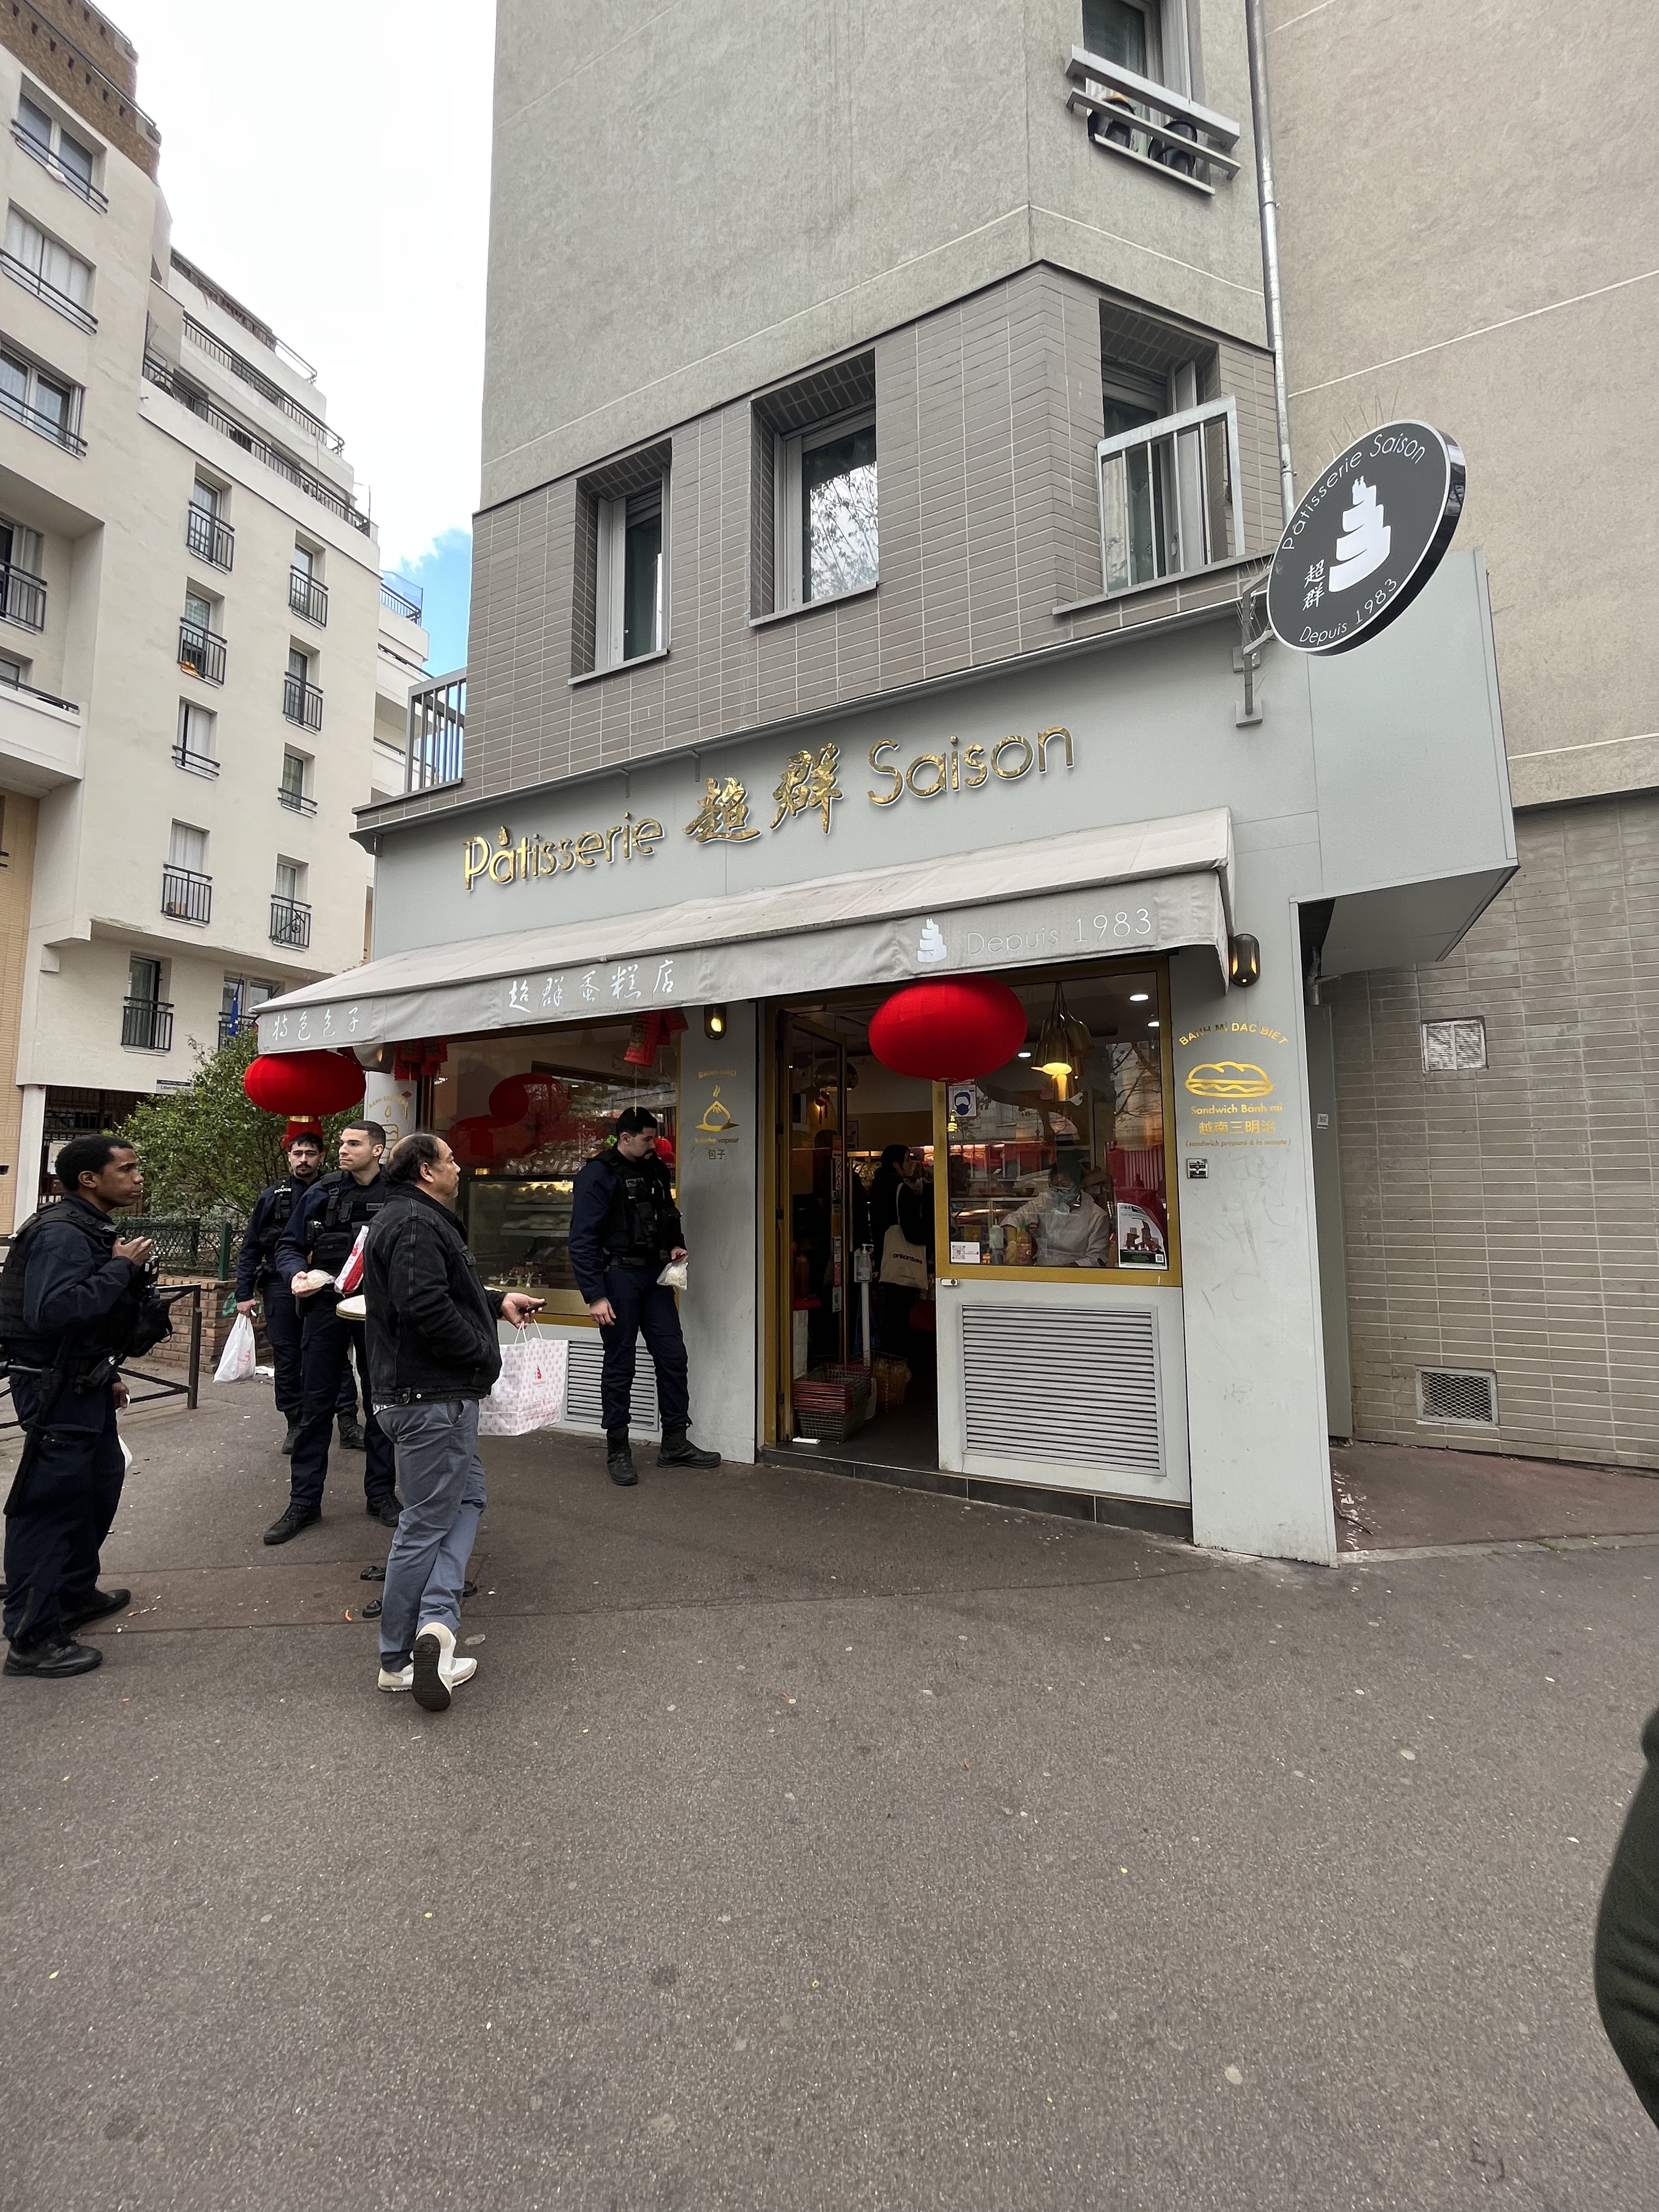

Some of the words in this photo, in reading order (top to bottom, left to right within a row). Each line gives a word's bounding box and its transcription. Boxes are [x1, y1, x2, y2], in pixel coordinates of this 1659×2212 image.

[1282, 452, 1362, 550] Pâtisserie
[1369, 433, 1426, 465] Saison
[1302, 559, 1325, 611] 超群
[1299, 622, 1347, 646] Depuis
[1355, 578, 1397, 625] 1983
[867, 725, 1074, 806] Saison
[682, 742, 844, 845] 超群
[967, 927, 1058, 956] Depuis
[1073, 908, 1152, 943] 1983
[509, 960, 675, 1013] 超群蛋糕店
[1191, 1103, 1238, 1114] Sandwich
[1199, 1120, 1276, 1136] 越南三明治
[708, 1149, 726, 1160] 包子
